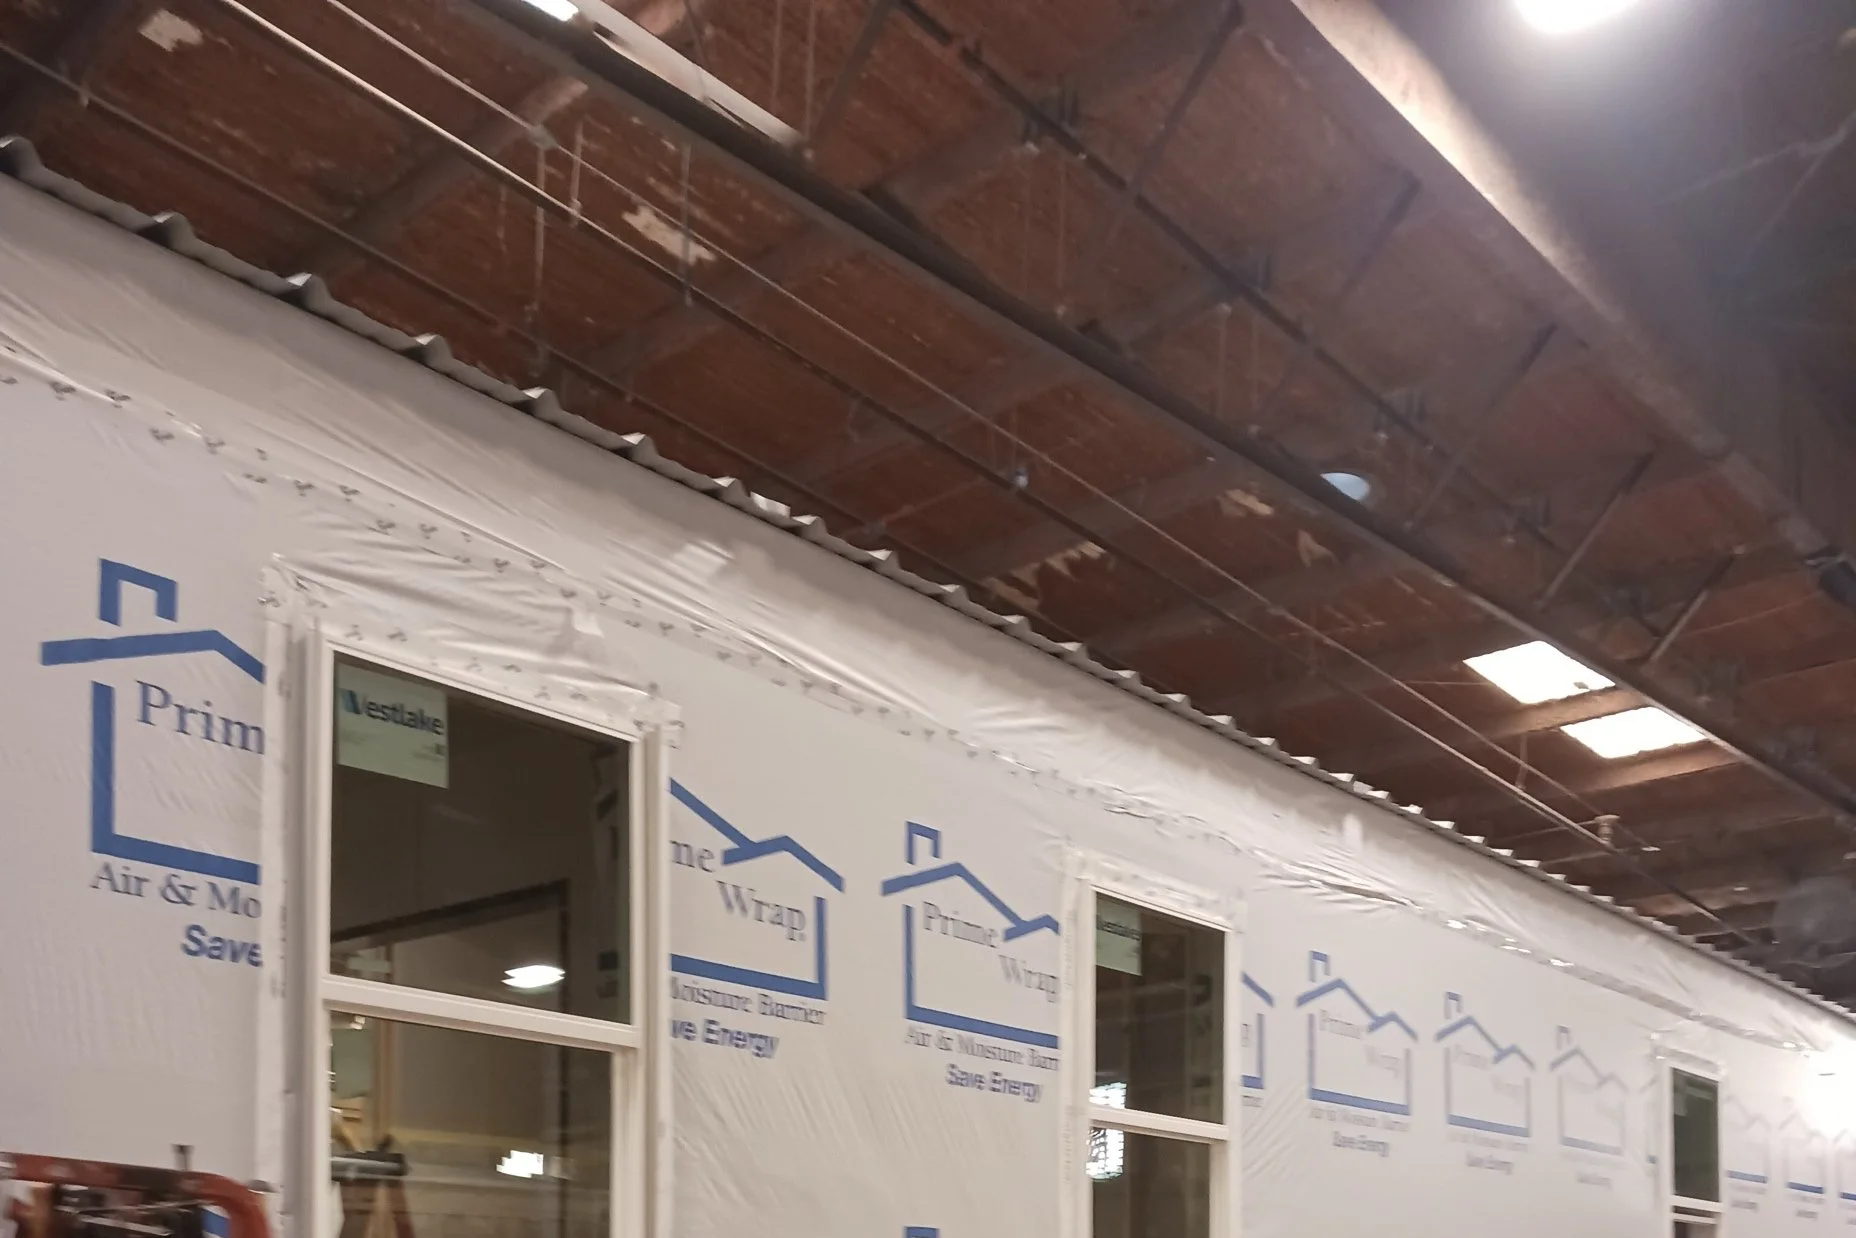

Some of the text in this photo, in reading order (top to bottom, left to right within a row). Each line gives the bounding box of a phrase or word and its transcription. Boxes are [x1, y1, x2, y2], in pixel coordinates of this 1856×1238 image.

[136, 680, 265, 755] Prim
[90, 862, 151, 898] Air
[158, 873, 198, 906] &
[716, 880, 807, 942] Wrap
[922, 900, 999, 949] Prime
[181, 924, 264, 967] Save
[757, 992, 825, 1026] Barrier
[671, 1018, 780, 1058] ve Energy
